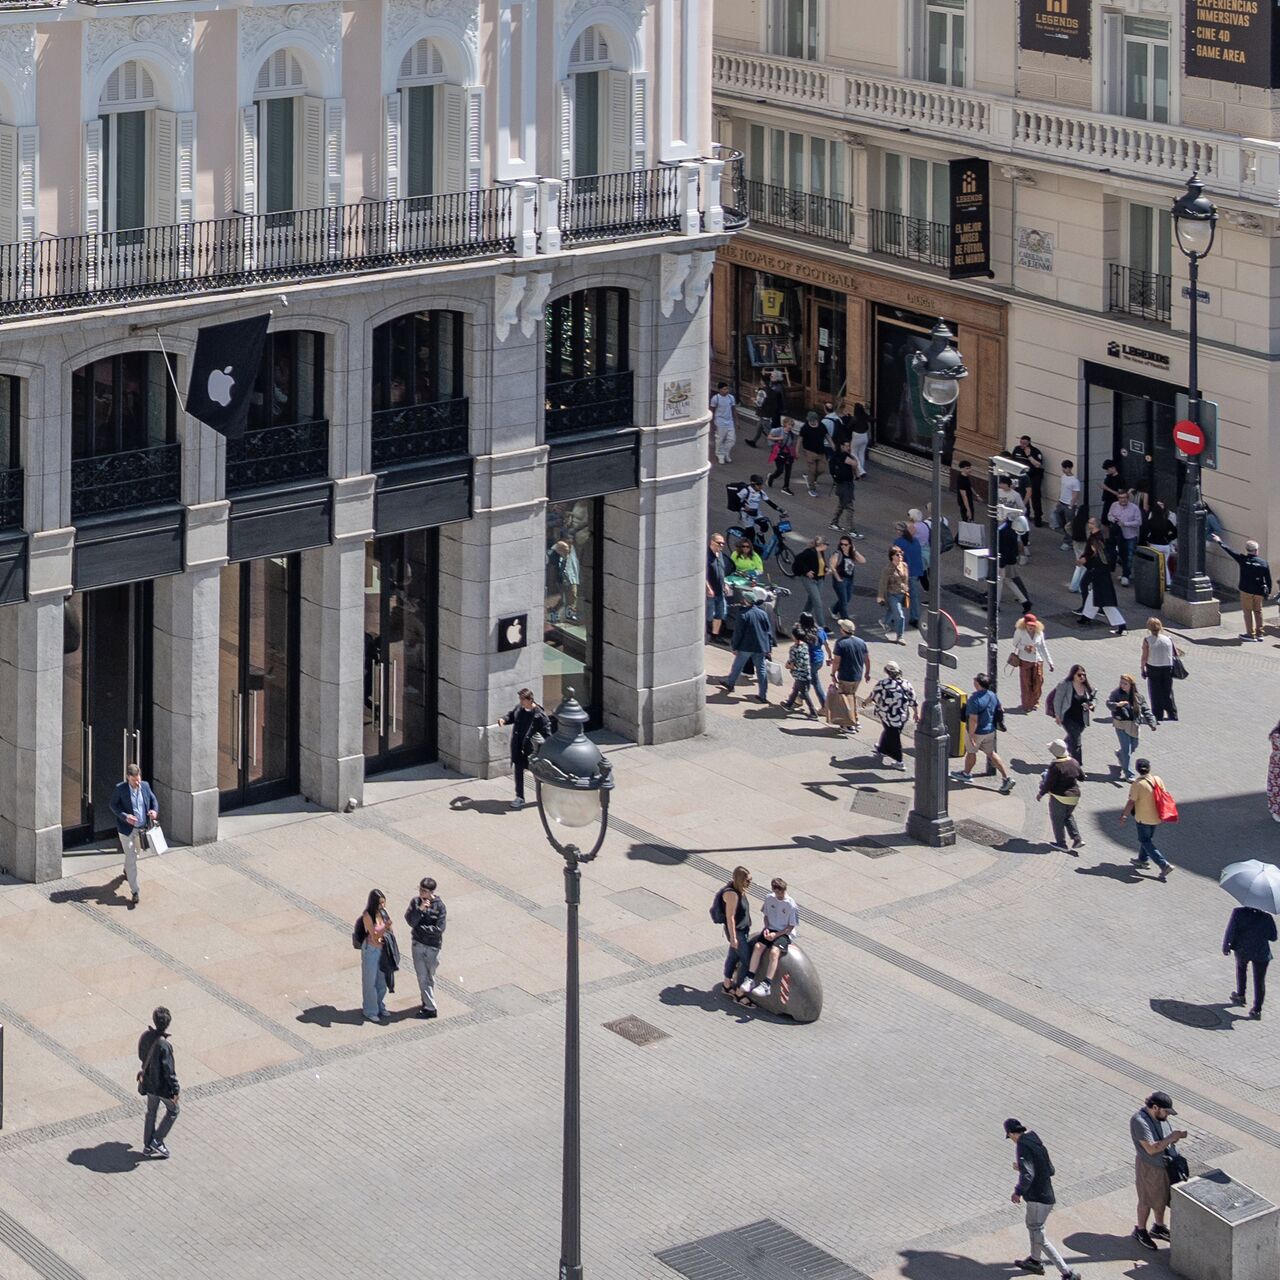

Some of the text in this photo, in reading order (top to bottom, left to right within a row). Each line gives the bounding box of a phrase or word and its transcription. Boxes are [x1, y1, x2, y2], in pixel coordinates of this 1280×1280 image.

[1035, 13, 1079, 28] LEGENDS
[1197, 8, 1250, 27] INMERSIVAS
[1196, 26, 1230, 42] CINE 4D
[1196, 44, 1246, 63] GAME AREA
[741, 249, 774, 268] HOME
[796, 265, 858, 290] FOOTBALL
[768, 296, 775, 308] 9
[1122, 344, 1169, 365] LEGENDS
